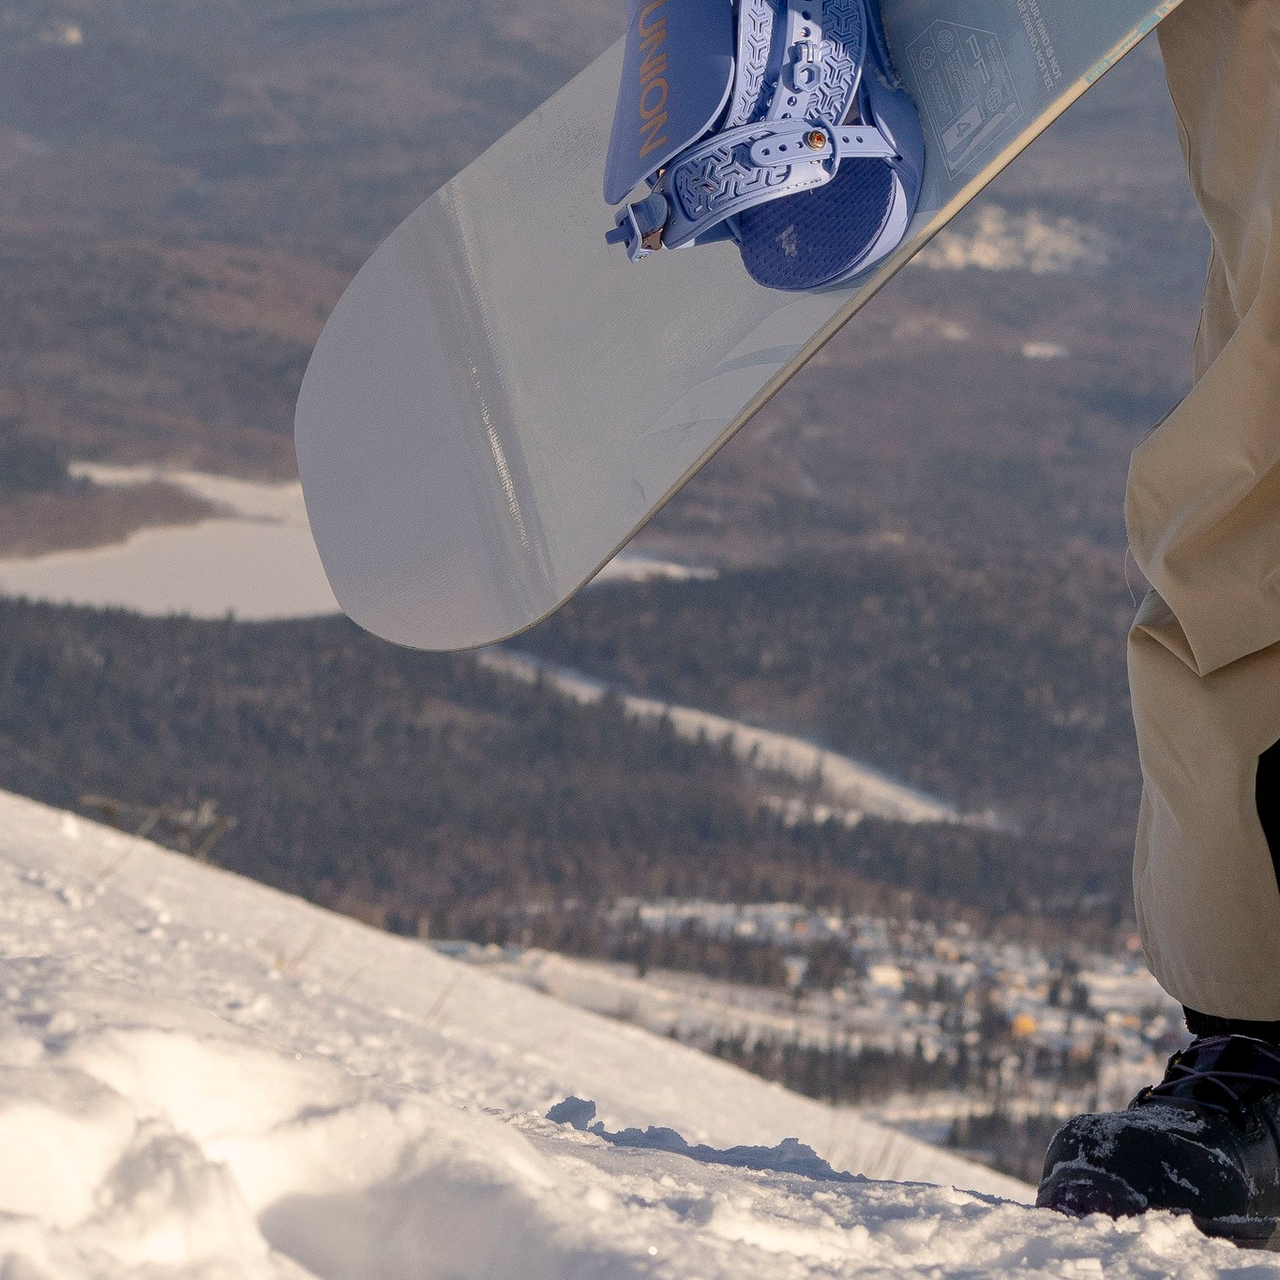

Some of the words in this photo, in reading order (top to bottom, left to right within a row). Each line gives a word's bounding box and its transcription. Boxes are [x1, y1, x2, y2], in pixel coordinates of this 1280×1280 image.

[1035, 18, 1050, 46] MIND
[1033, 49, 1047, 71] NOT
[1044, 46, 1054, 57] IS
[1048, 56, 1062, 79] NOT
[955, 121, 972, 140] 4
